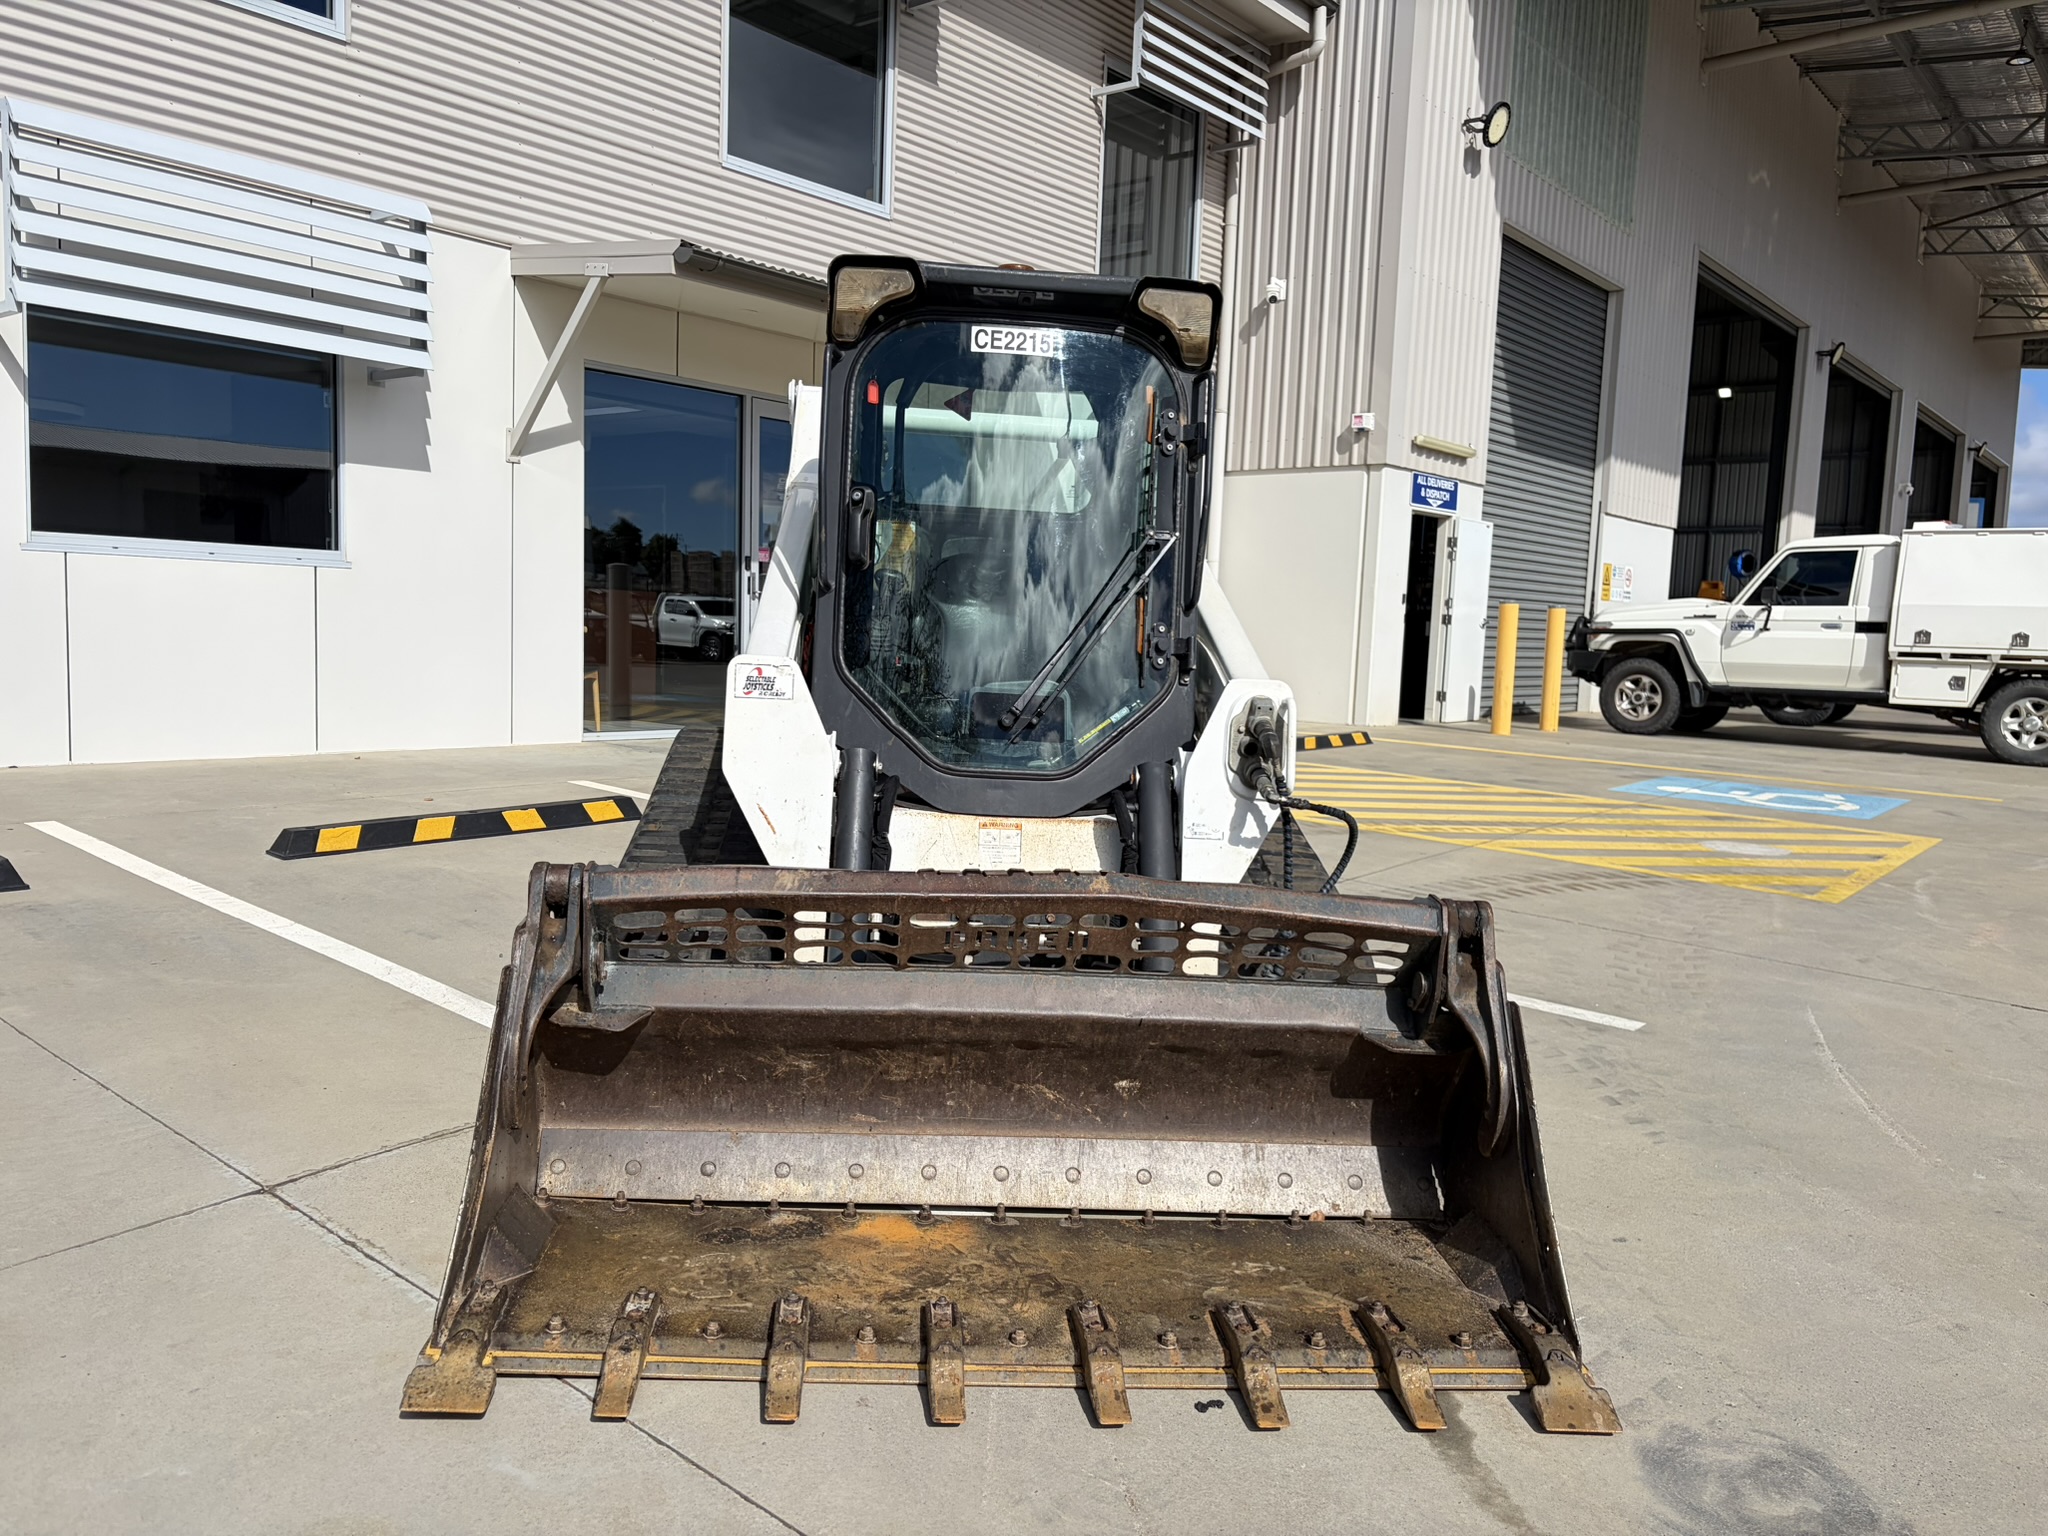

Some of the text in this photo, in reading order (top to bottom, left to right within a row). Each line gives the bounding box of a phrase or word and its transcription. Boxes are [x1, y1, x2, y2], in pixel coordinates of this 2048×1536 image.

[973, 328, 1051, 354] CE2215
[1417, 476, 1455, 491] ALL DELIVERIES
[1420, 487, 1450, 501] & DISPATCH
[742, 682, 775, 691] JOYSTICKS
